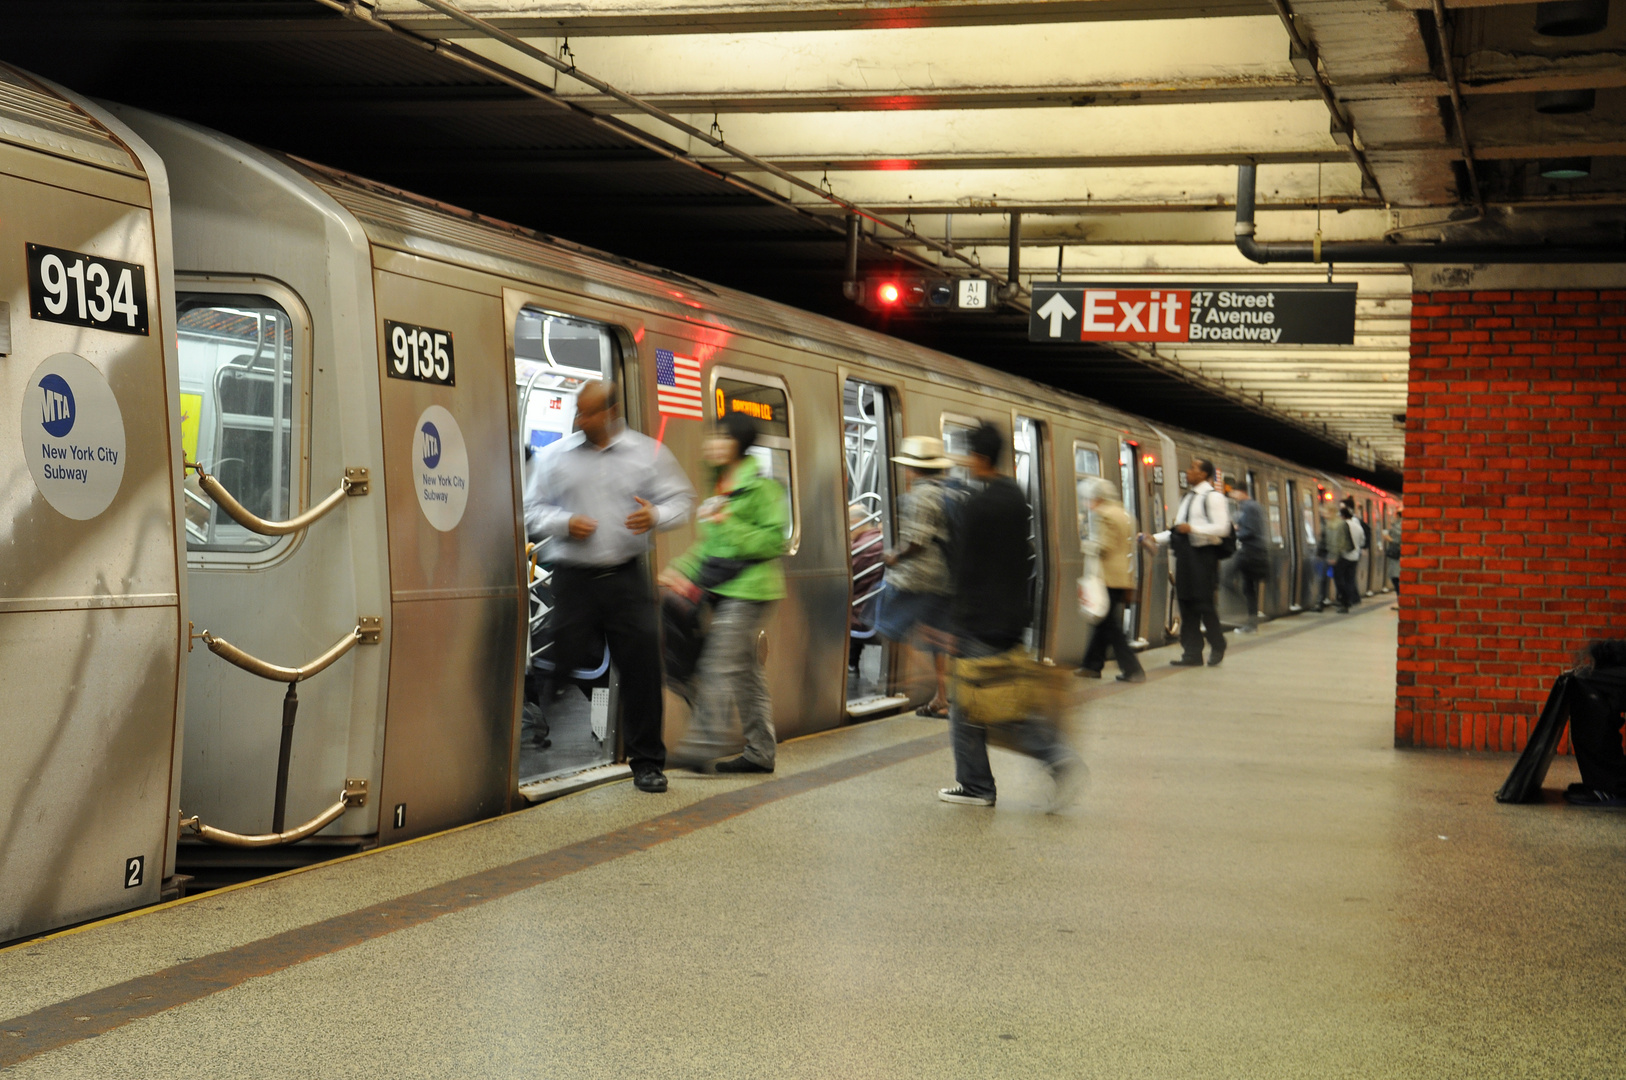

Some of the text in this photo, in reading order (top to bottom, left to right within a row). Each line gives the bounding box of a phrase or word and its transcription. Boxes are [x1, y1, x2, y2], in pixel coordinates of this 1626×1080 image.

[40, 253, 138, 327] 9134
[966, 295, 980, 306] 26
[1191, 291, 1275, 308] 47 Street
[1082, 290, 1183, 334] Exit
[1190, 308, 1275, 324] 7 Avenue
[1189, 323, 1282, 344] Broadway
[391, 326, 450, 381] 9135
[38, 384, 72, 425] MTA
[42, 444, 118, 465] New York City
[421, 429, 440, 460] MTA
[44, 464, 88, 483] Subway
[422, 473, 465, 490] New York City
[423, 489, 448, 503] Subway
[396, 805, 404, 827] 1
[127, 858, 140, 887] 2
